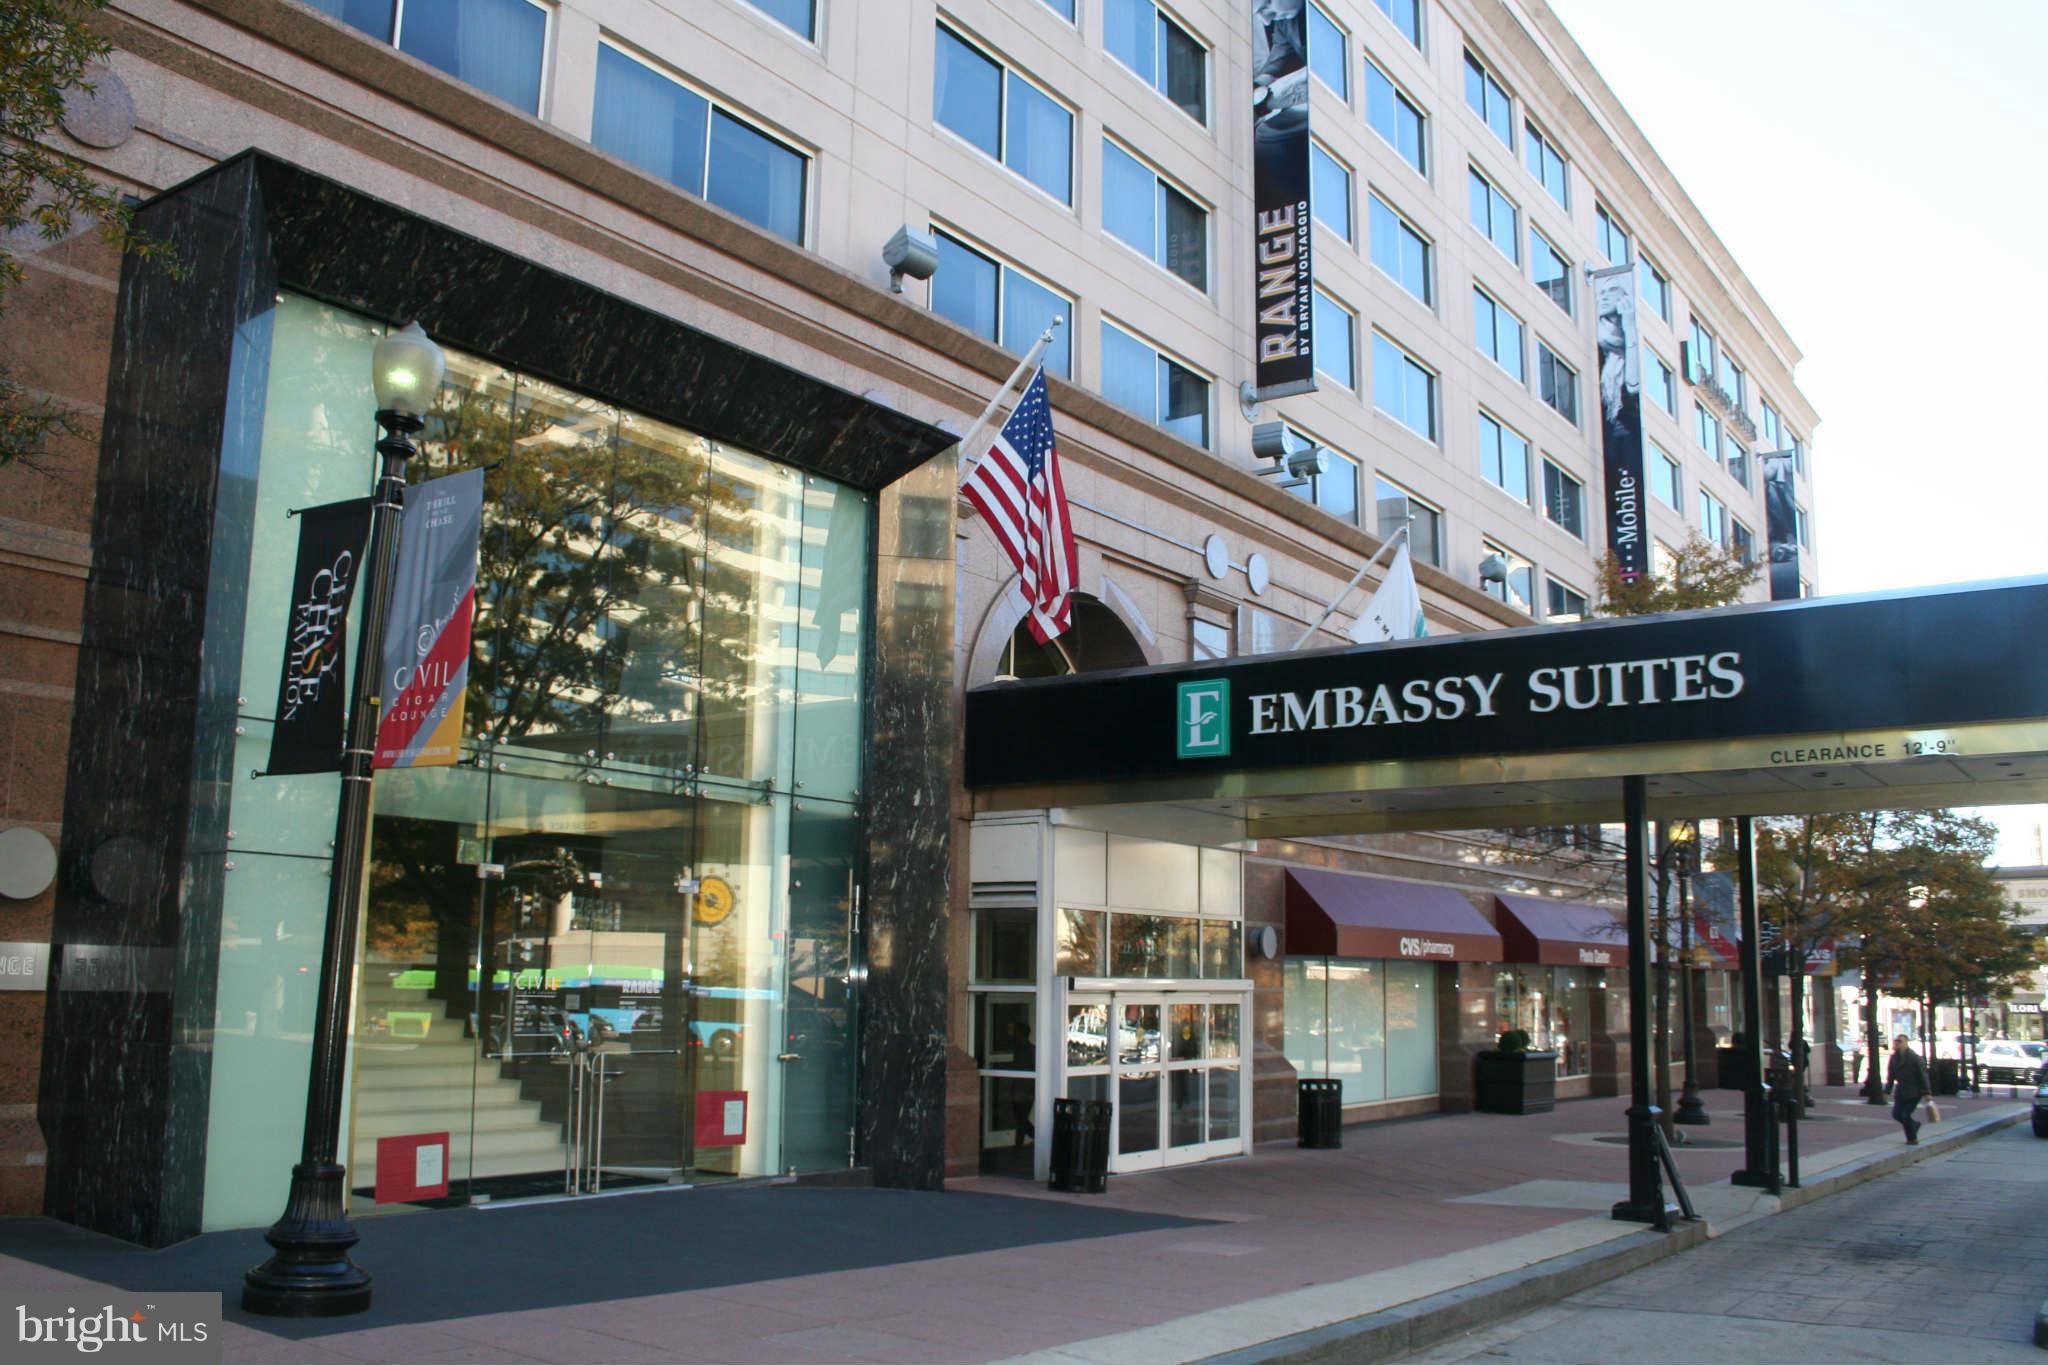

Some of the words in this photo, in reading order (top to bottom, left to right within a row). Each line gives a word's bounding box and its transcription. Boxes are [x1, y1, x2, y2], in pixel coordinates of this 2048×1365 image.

[1297, 200, 1309, 279] VOLTAGGIO
[1259, 204, 1297, 363] RANGE
[1300, 284, 1309, 330] BRYAN
[1300, 338, 1310, 356] BY
[1615, 476, 1638, 545] Mobile
[297, 568, 334, 704] CHASE
[283, 601, 312, 720] PAVILION
[393, 661, 451, 690] CIVIL
[391, 692, 449, 707] CIGAR
[391, 707, 449, 722] LOUNGE
[1248, 672, 1503, 735] EMBASSY
[1528, 652, 1744, 712] SUITES
[1771, 744, 1886, 763] CLEARANCE
[516, 975, 557, 990] CIVIL
